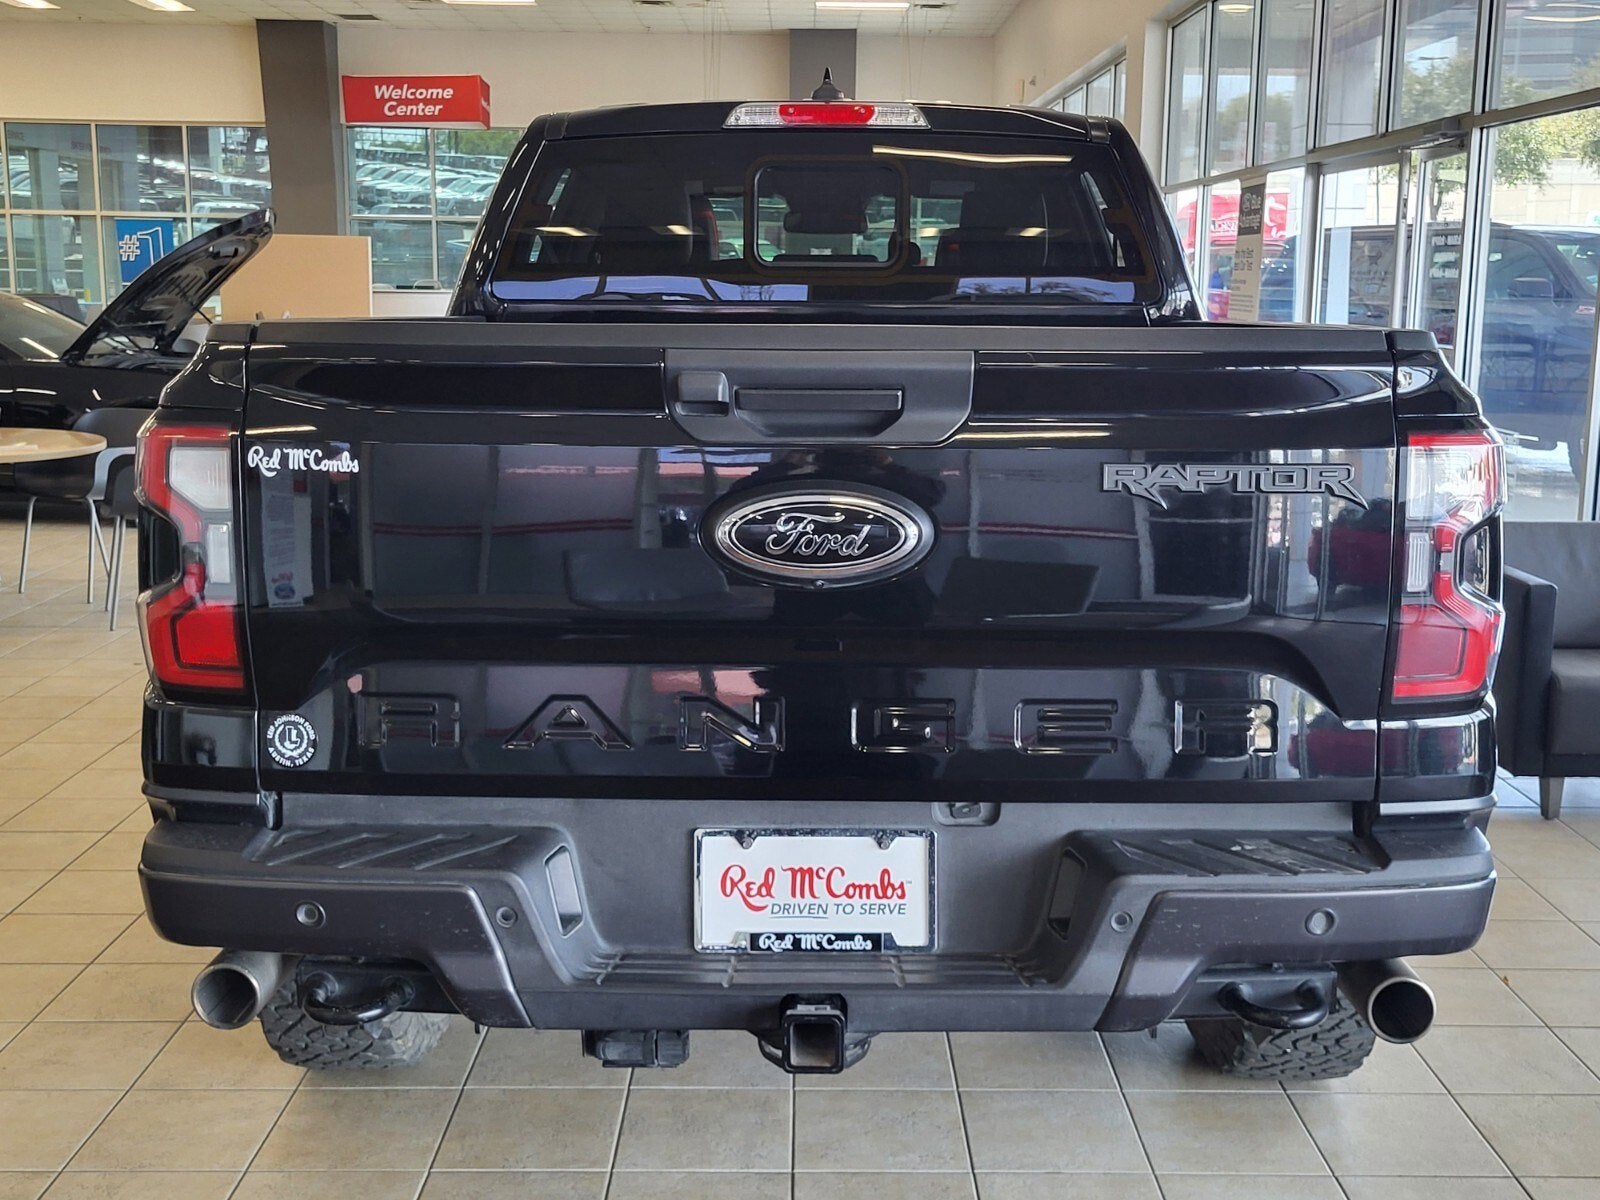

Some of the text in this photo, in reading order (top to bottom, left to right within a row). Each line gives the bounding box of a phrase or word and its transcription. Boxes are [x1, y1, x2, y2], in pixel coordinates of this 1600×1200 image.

[374, 84, 454, 99] Welcome
[384, 101, 443, 116] Center
[119, 227, 165, 266] #1
[248, 446, 359, 477] Red McCombs
[1103, 463, 1369, 510] RAPTOR
[765, 512, 872, 556] Ford
[303, 721, 316, 740] FORD
[358, 693, 1280, 756] RANGER
[295, 747, 315, 766] TEXAS
[720, 864, 906, 912] Red McCombs
[770, 902, 907, 916] DRIVEN TO SERVE
[758, 933, 873, 953] Red McCombs
